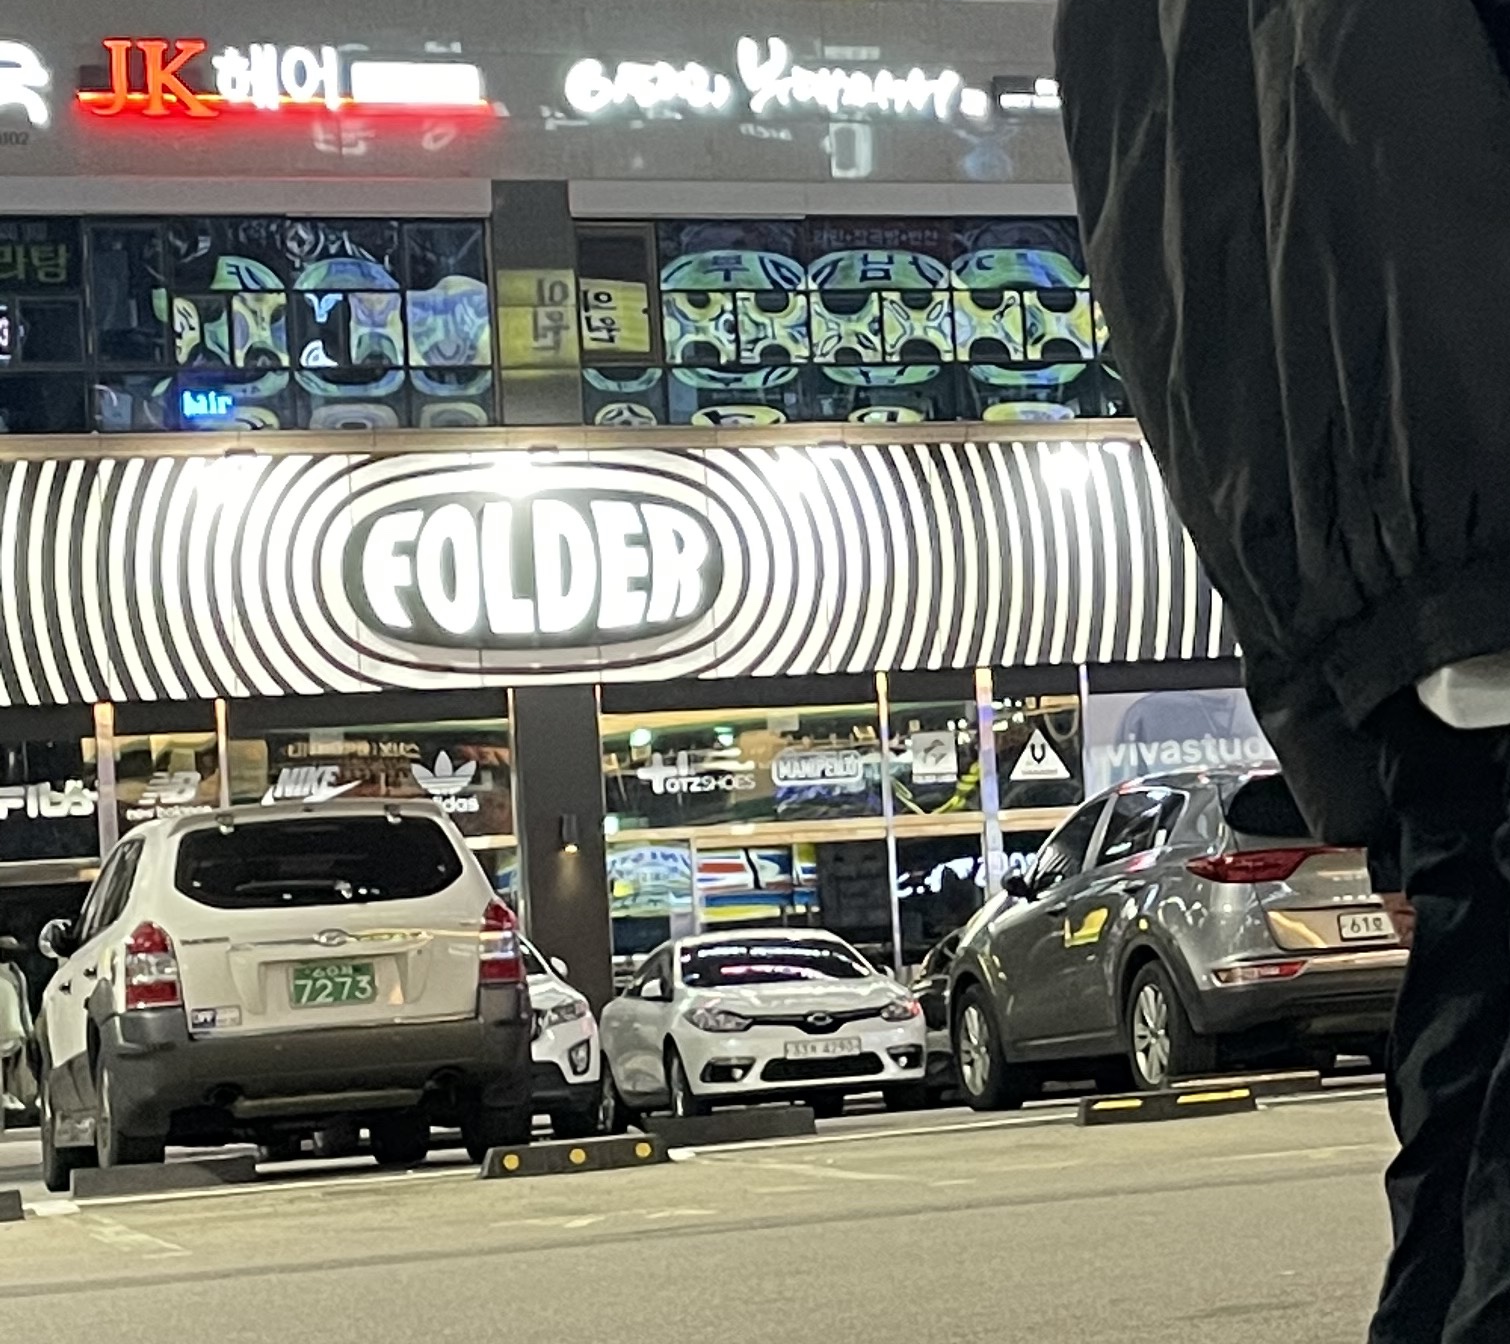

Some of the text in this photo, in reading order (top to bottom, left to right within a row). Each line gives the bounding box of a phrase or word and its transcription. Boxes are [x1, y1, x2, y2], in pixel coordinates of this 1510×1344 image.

[362, 498, 708, 635] FOLDER
[273, 765, 341, 799] NIKE
[294, 974, 373, 1005] 7273
